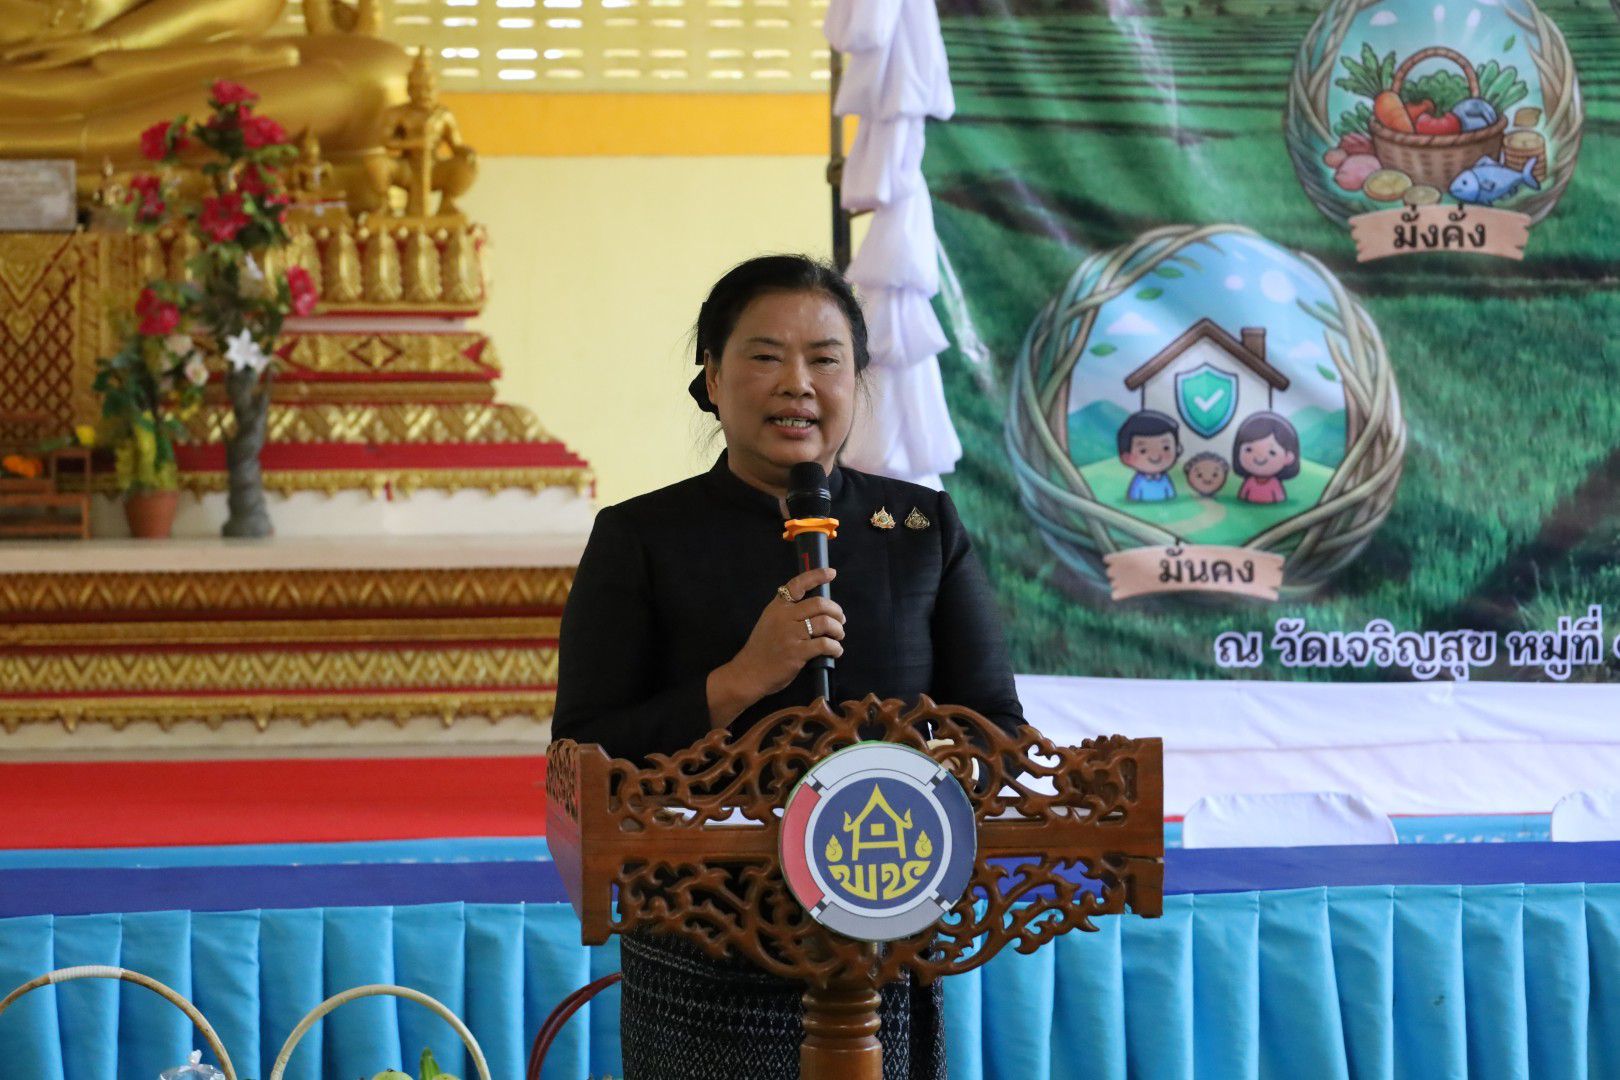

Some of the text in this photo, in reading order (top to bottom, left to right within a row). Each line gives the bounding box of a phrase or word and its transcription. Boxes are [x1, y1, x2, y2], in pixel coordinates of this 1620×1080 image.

[1393, 203, 1486, 248] มั่งคั่ง
[1158, 537, 1255, 583] มั่นคง
[1217, 633, 1260, 665] ณ
[1273, 620, 1496, 679] วัดเจริญสุข
[1508, 606, 1602, 679] หมู่ที่
